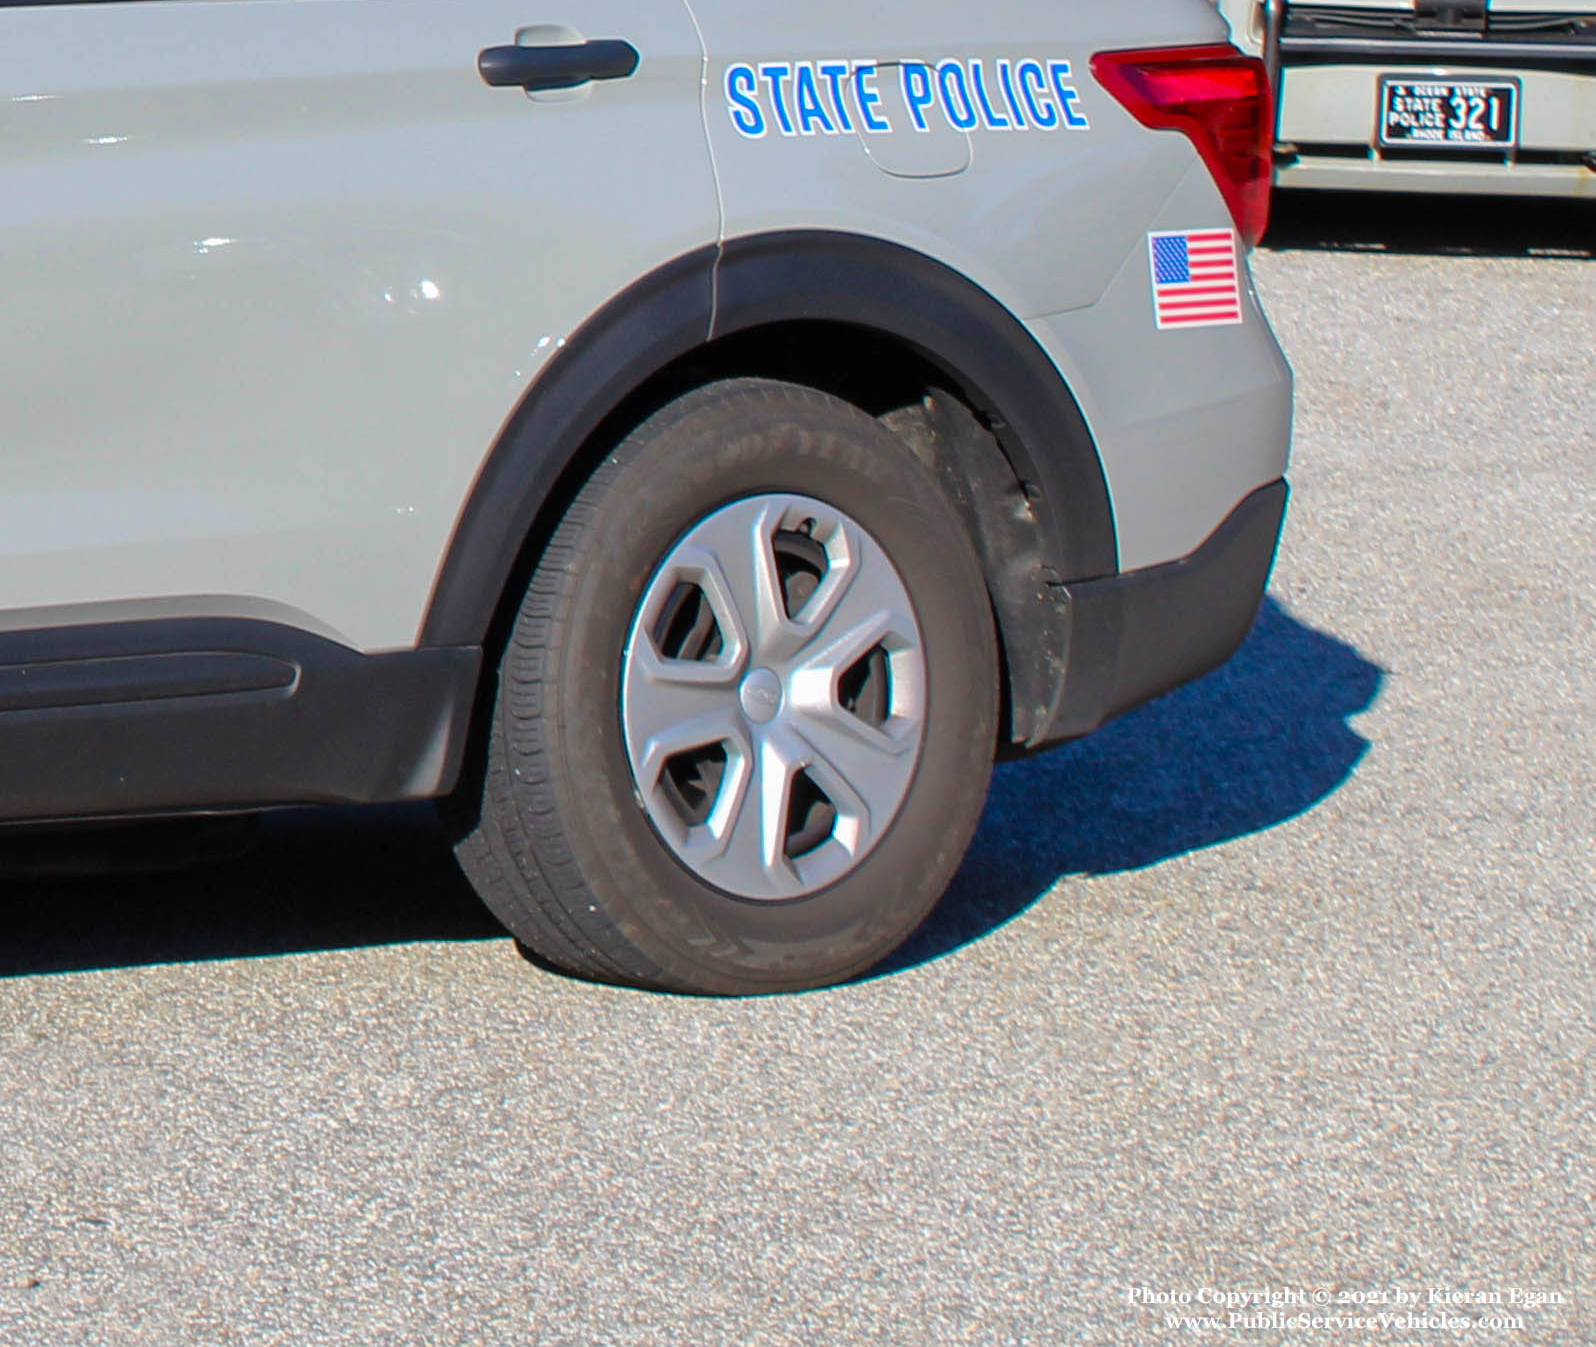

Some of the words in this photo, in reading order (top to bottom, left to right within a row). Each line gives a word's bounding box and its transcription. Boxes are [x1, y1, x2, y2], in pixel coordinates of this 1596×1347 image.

[723, 59, 893, 139] STATE
[899, 58, 1090, 133] POLICE
[1392, 96, 1444, 112] STATE
[1388, 112, 1446, 128] POLICE
[1448, 96, 1501, 131] 321
